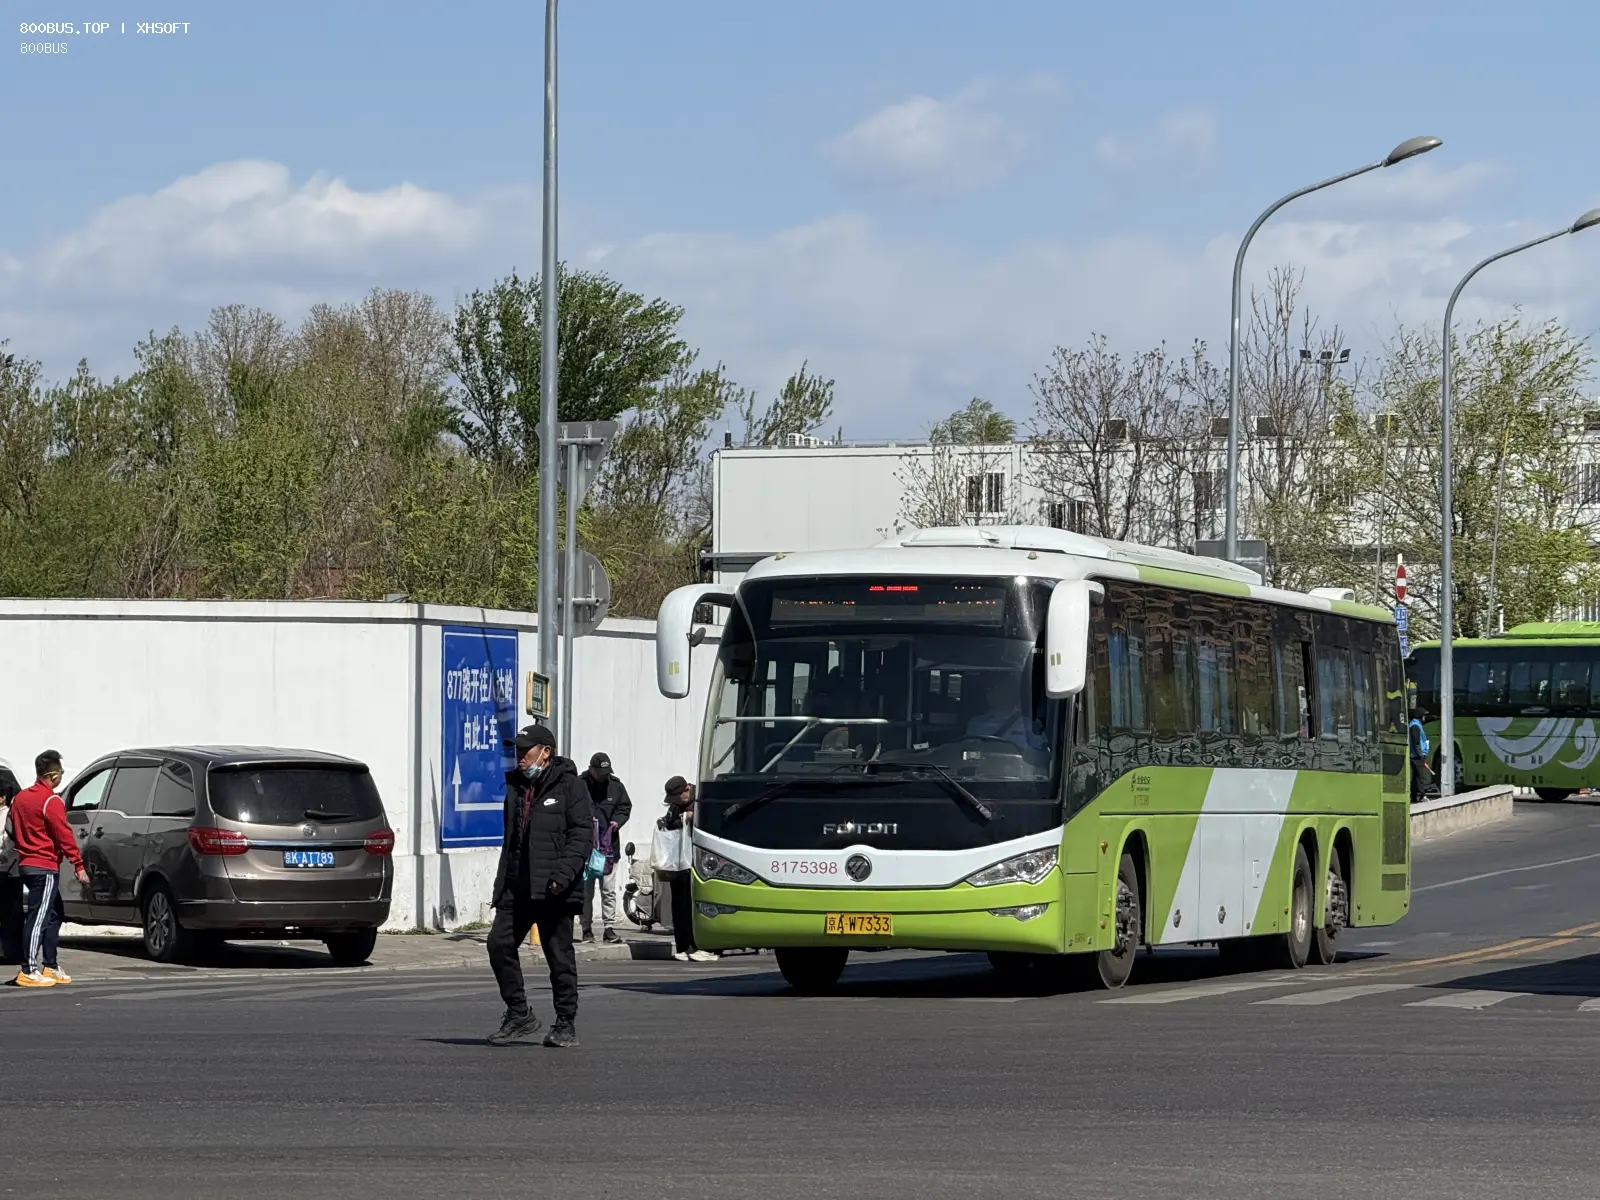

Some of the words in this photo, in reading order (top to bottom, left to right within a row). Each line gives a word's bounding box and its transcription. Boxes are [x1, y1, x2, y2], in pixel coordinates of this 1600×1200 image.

[463, 714, 498, 751] 由此上车
[822, 822, 898, 835] FOTON
[770, 860, 838, 875] 8175398
